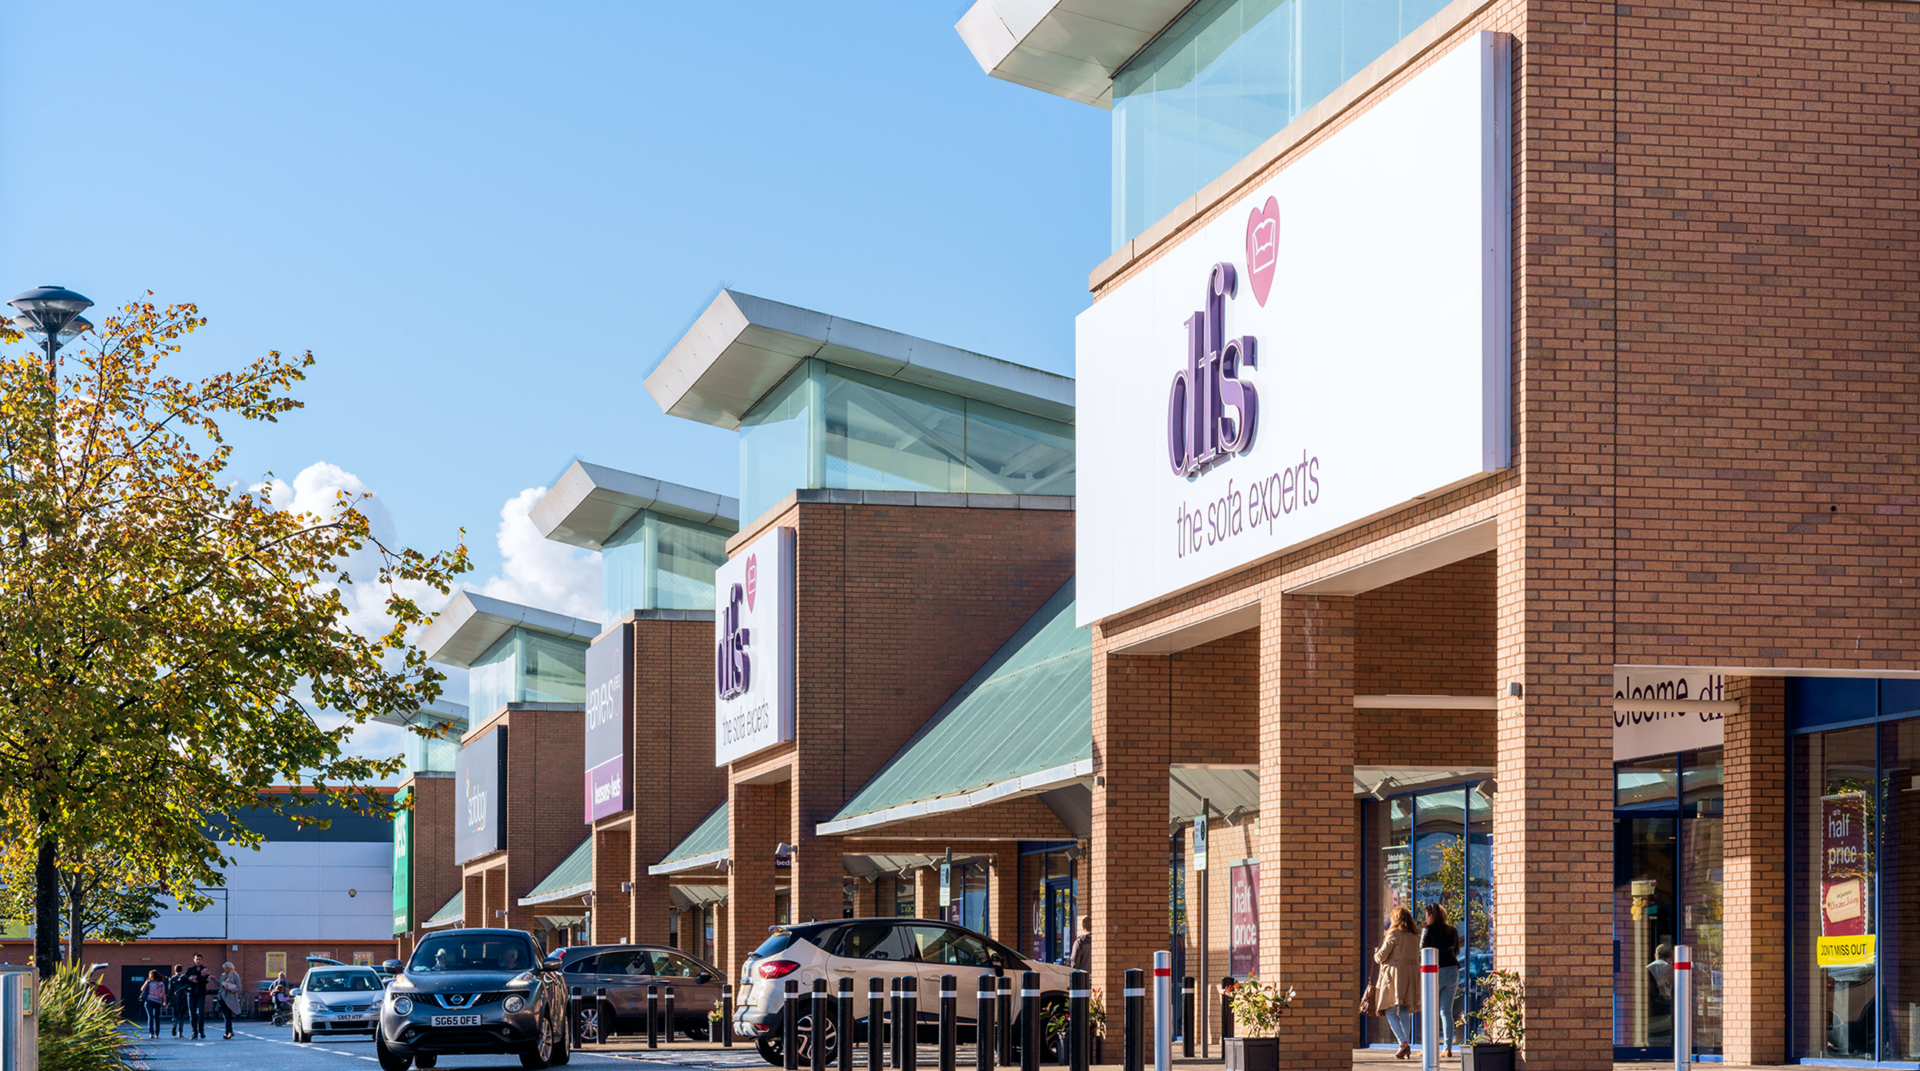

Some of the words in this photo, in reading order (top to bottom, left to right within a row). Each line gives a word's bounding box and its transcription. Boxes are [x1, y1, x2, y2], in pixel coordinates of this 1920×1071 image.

[1168, 262, 1258, 481] dfs
[1177, 501, 1202, 558] the
[1207, 479, 1242, 546] sofa
[1249, 449, 1320, 535] experts
[717, 583, 751, 702] dfs
[722, 713, 732, 746] the
[733, 705, 746, 742] sofa
[747, 697, 770, 743] experts
[1828, 813, 1850, 838] half
[1828, 840, 1857, 870] price
[1234, 885, 1251, 914] half
[1234, 917, 1257, 951] price
[1834, 944, 1850, 956] MISS
[1850, 943, 1867, 956] OUT
[435, 1016, 458, 1026] SG65
[460, 1016, 478, 1025] OFE
